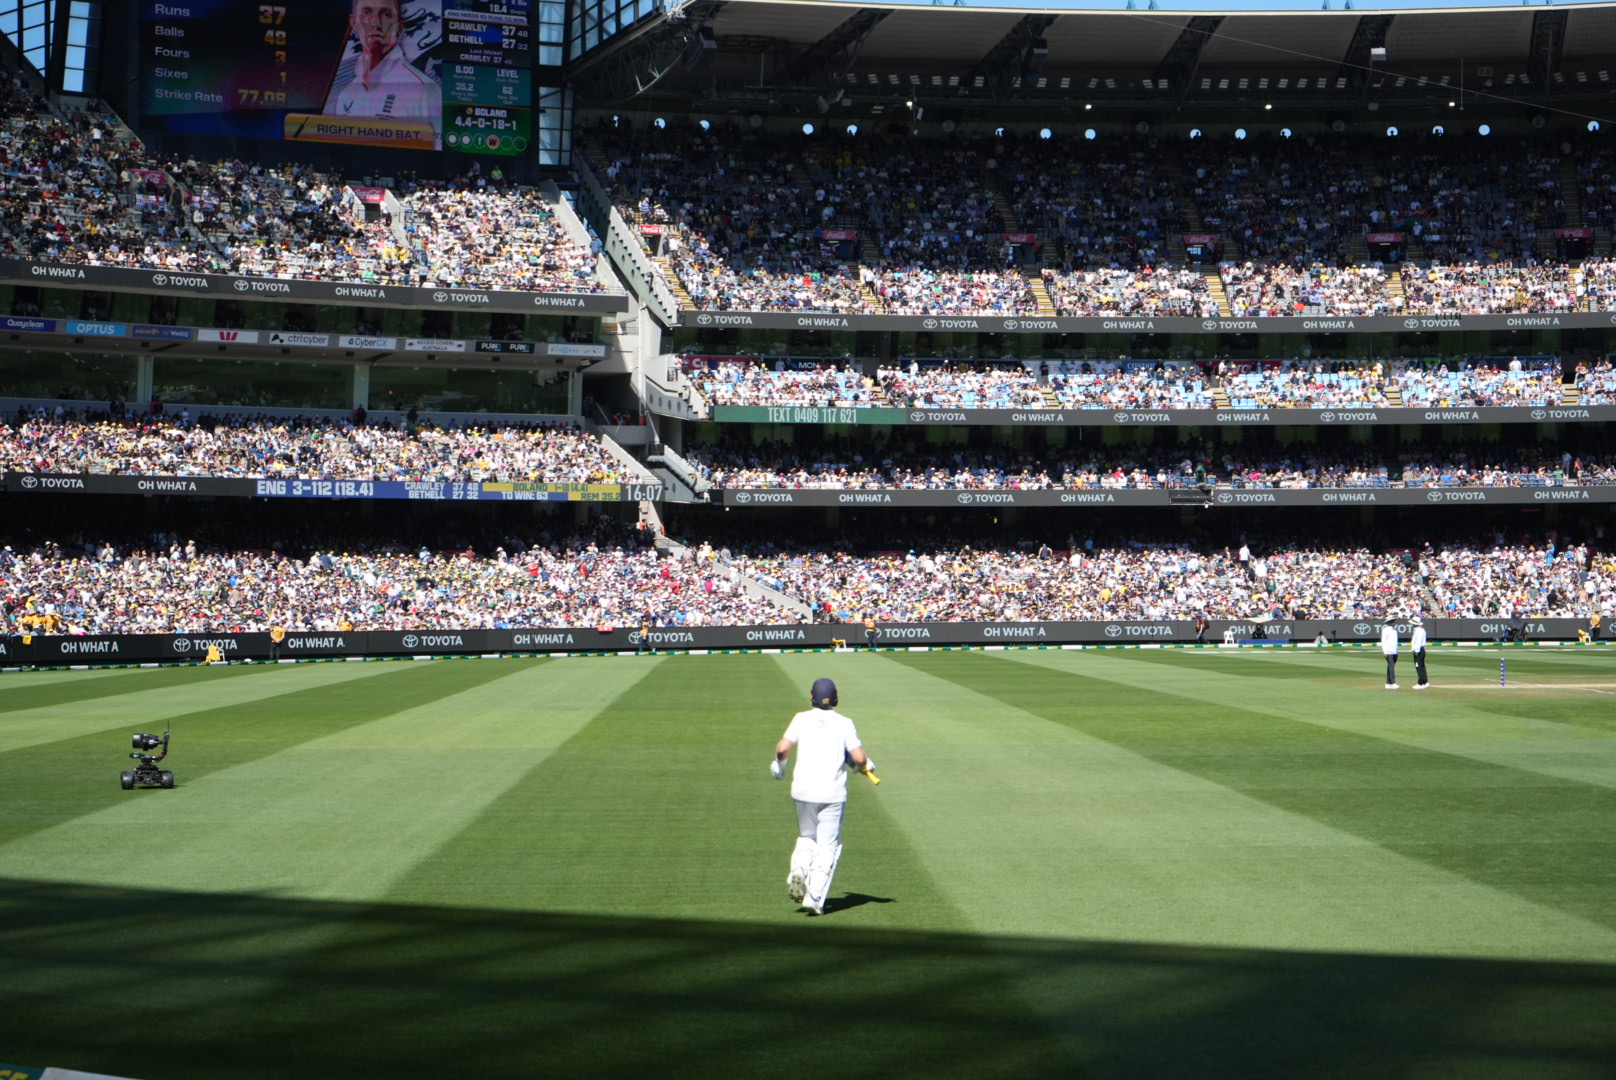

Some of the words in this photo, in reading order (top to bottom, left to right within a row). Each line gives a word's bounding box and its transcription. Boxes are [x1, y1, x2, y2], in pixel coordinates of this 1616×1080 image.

[489, 4, 507, 13] 18.4
[155, 4, 190, 16] Runs
[259, 5, 286, 24] 37
[449, 22, 487, 32] CRAWLEY
[502, 26, 516, 36] 37
[155, 26, 184, 37] Balls
[264, 30, 286, 45] 48
[449, 34, 483, 44] BETHELL
[502, 39, 516, 48] 27
[155, 47, 190, 58] Fours
[460, 54, 490, 62] CRAWLEY
[456, 66, 473, 74] 6.00
[497, 69, 518, 78] LEVEL
[155, 68, 188, 79] Sixes
[280, 72, 286, 83] 1
[456, 82, 474, 91] 35.2
[155, 89, 191, 100] Strike
[195, 92, 223, 102] Rate
[238, 89, 286, 106] 77.08
[475, 108, 507, 117] BOLAND
[455, 116, 516, 130] 4.4-0-18-1
[318, 124, 354, 134] RIGHT
[358, 128, 392, 137] HAND
[396, 130, 420, 140] BAT
[355, 189, 381, 200] Coca-Cola
[32, 266, 46, 275] OH
[48, 267, 76, 277] WHAT
[78, 270, 85, 278] A
[170, 276, 207, 287] TOYOTA
[251, 282, 289, 292] TOYOTA
[335, 287, 349, 295] OH
[351, 288, 377, 297] WHAT
[450, 294, 489, 302] TOYOTA
[535, 297, 548, 305] OH
[550, 298, 576, 306] WHAT
[8, 319, 44, 328] Quayclean
[714, 316, 752, 324] TOYOTA
[814, 318, 840, 326] WHAT
[940, 320, 978, 328] TOYOTA
[1421, 319, 1460, 327] TOYOTA
[77, 324, 114, 334] OPTUS
[1219, 321, 1257, 329] TOYOTA
[355, 338, 386, 347] CyberCX
[768, 407, 791, 423] TEXT
[794, 407, 819, 423] 0409
[822, 407, 837, 423] 117
[839, 407, 857, 423] 621
[1549, 410, 1589, 418] TOYOTA
[41, 478, 84, 488] TOYOTA
[138, 481, 154, 489] OH
[157, 481, 187, 490] WHAT
[189, 482, 196, 490] A
[405, 482, 445, 491] CRAWLEY
[453, 483, 463, 491] 37
[467, 483, 478, 491] 48
[258, 481, 286, 494] ENG
[293, 481, 332, 495] 3-112
[335, 482, 373, 496] (18.4)
[570, 484, 588, 492] (4.4)
[409, 491, 445, 499] BETHELL
[453, 491, 463, 500] 27
[467, 491, 478, 500] 32
[581, 493, 599, 501] REM
[602, 493, 620, 501] 35.2
[626, 485, 663, 502] 16:07
[753, 494, 792, 502] TOYOTA
[839, 494, 853, 502] OH
[855, 494, 882, 502] WHAT
[975, 494, 1014, 502] TOYOTA
[1061, 494, 1075, 502] OH
[1077, 494, 1105, 502] WHAT
[1445, 492, 1485, 500] TOYOTA
[885, 628, 930, 637] TOYOTA
[984, 628, 1000, 636] OH
[1003, 627, 1035, 636] WHAT
[1037, 627, 1046, 636] A
[1125, 626, 1172, 635] TOYOTA
[1229, 626, 1245, 634] OH
[1283, 626, 1291, 634] A
[1481, 624, 1498, 633] OH
[1537, 624, 1545, 632] A
[514, 635, 530, 644] OH
[535, 634, 564, 643] WHAT
[566, 634, 573, 643] A
[648, 633, 694, 642] TOYOTA
[747, 631, 762, 640] OH
[765, 630, 795, 639] WHAT
[797, 630, 805, 639] A
[194, 640, 237, 650] TOYOTA
[288, 638, 303, 648] OH
[305, 638, 334, 648] WHAT
[337, 638, 345, 647] A
[421, 636, 462, 646] TOYOTA
[61, 642, 77, 653] OH
[79, 641, 109, 652] WHAT
[111, 641, 118, 652] A
